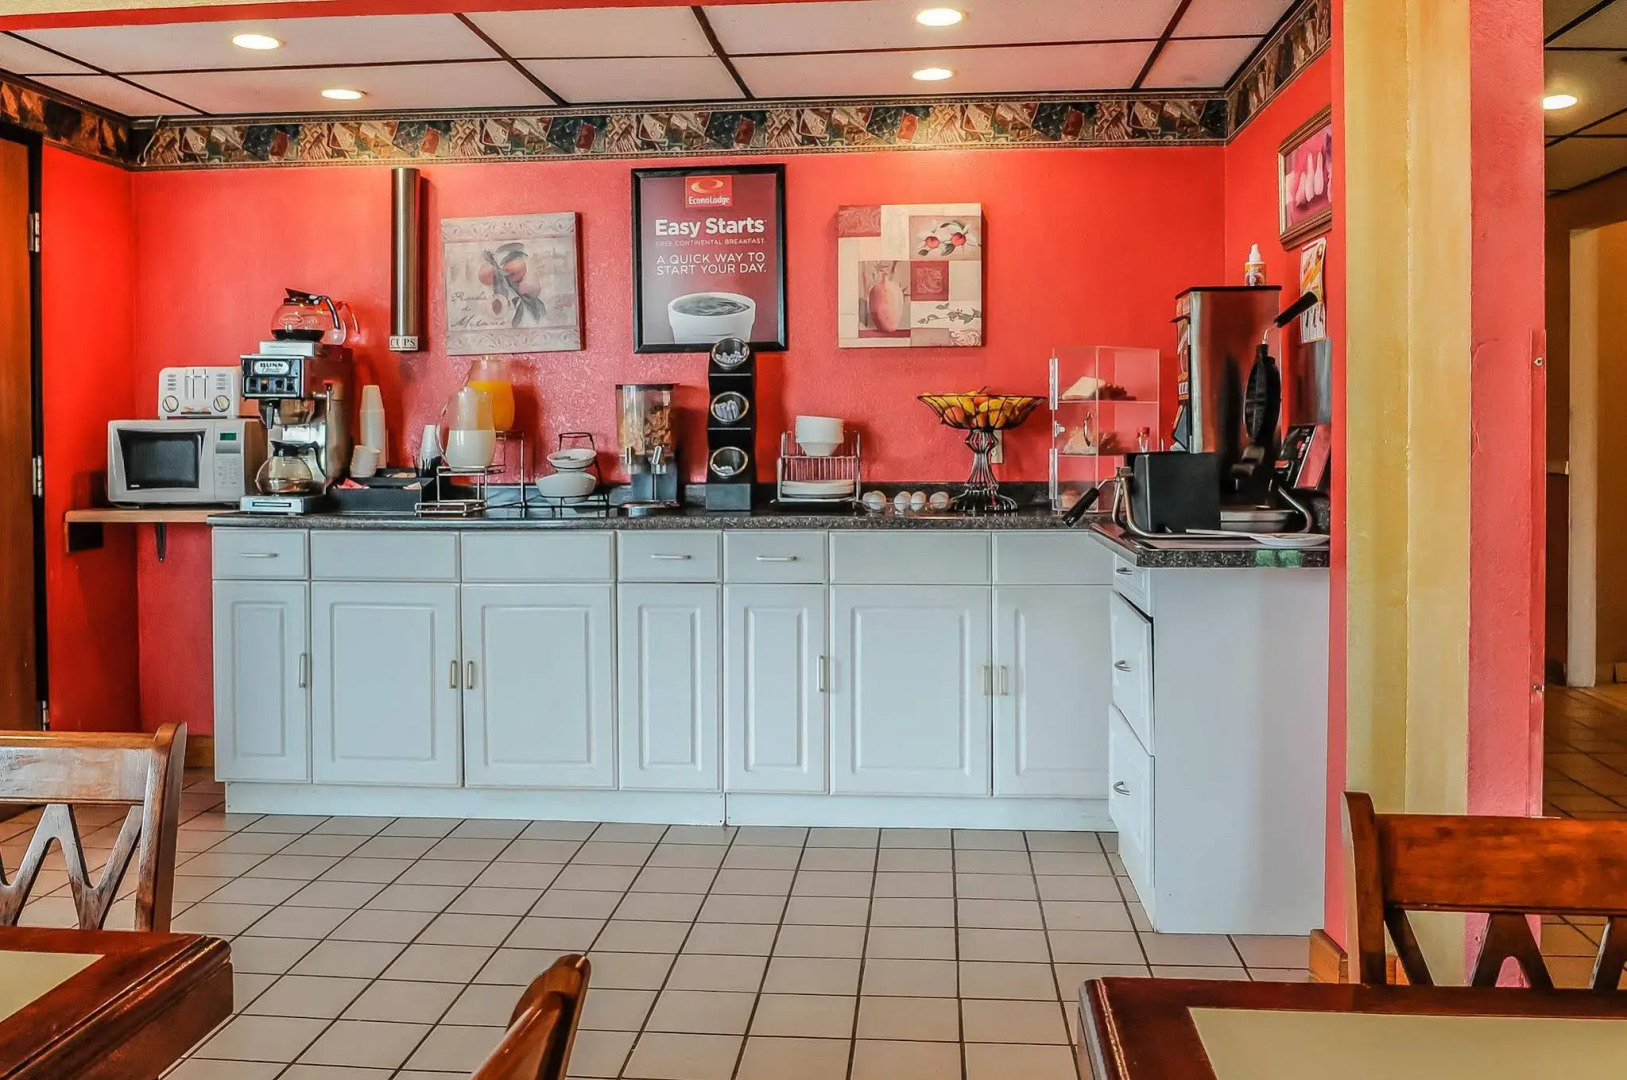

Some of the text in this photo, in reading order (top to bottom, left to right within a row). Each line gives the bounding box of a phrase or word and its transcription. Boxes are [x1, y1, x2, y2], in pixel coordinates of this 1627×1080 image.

[655, 217, 766, 238] Easy Starts
[675, 239, 722, 247] CONTINENTAL
[656, 252, 765, 265] A QUICK WAY TO
[657, 263, 767, 276] START YOUR DAY.
